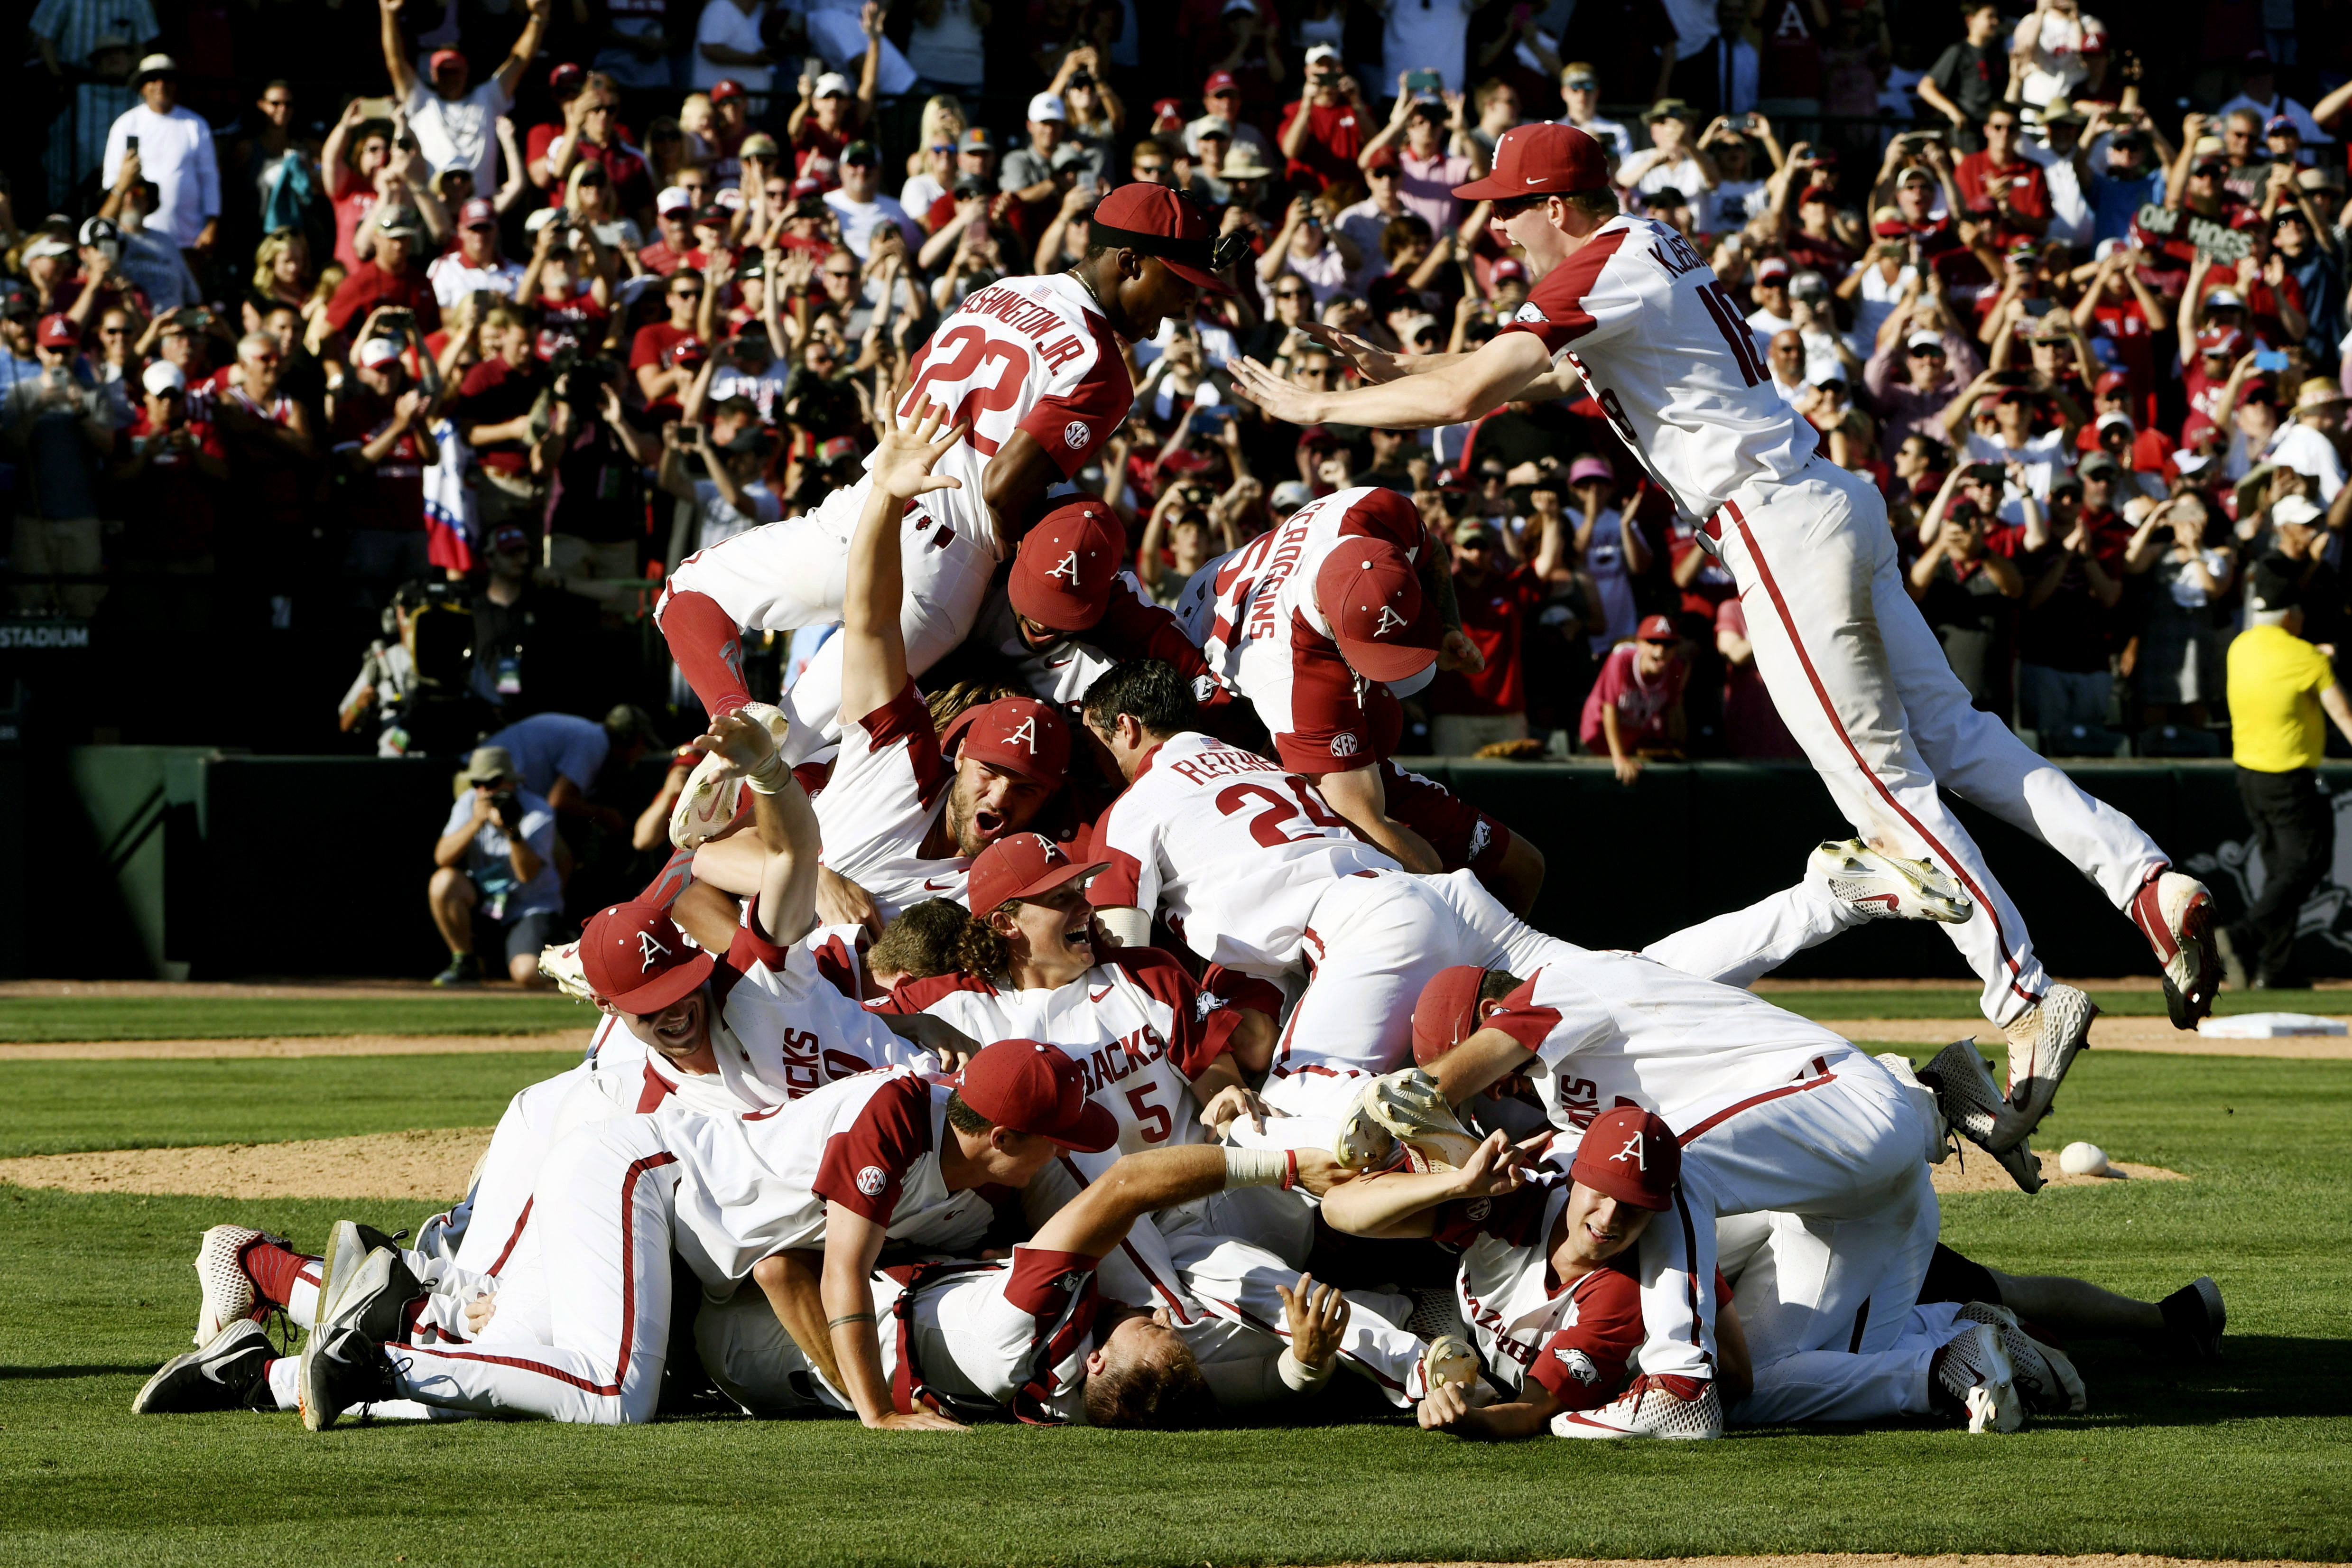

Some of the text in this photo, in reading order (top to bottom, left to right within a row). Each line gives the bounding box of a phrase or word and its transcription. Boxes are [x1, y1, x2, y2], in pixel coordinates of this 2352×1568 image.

[1777, 1, 1808, 37] A
[954, 287, 1066, 341] ASHINGTON
[1036, 334, 1085, 377] JR.
[898, 325, 1030, 457] 22
[1066, 423, 1089, 448] SEC
[1043, 550, 1079, 586] A
[0, 627, 89, 648] STADIUM
[1373, 605, 1407, 637] A
[1000, 716, 1037, 755] A
[1332, 734, 1356, 756] SEC
[1170, 752, 1285, 786] FLETCHE
[1033, 834, 1063, 863] A
[636, 931, 671, 974] A
[1125, 1081, 1172, 1143] 5
[1609, 1131, 1649, 1171] A
[857, 1168, 883, 1194] SEC
